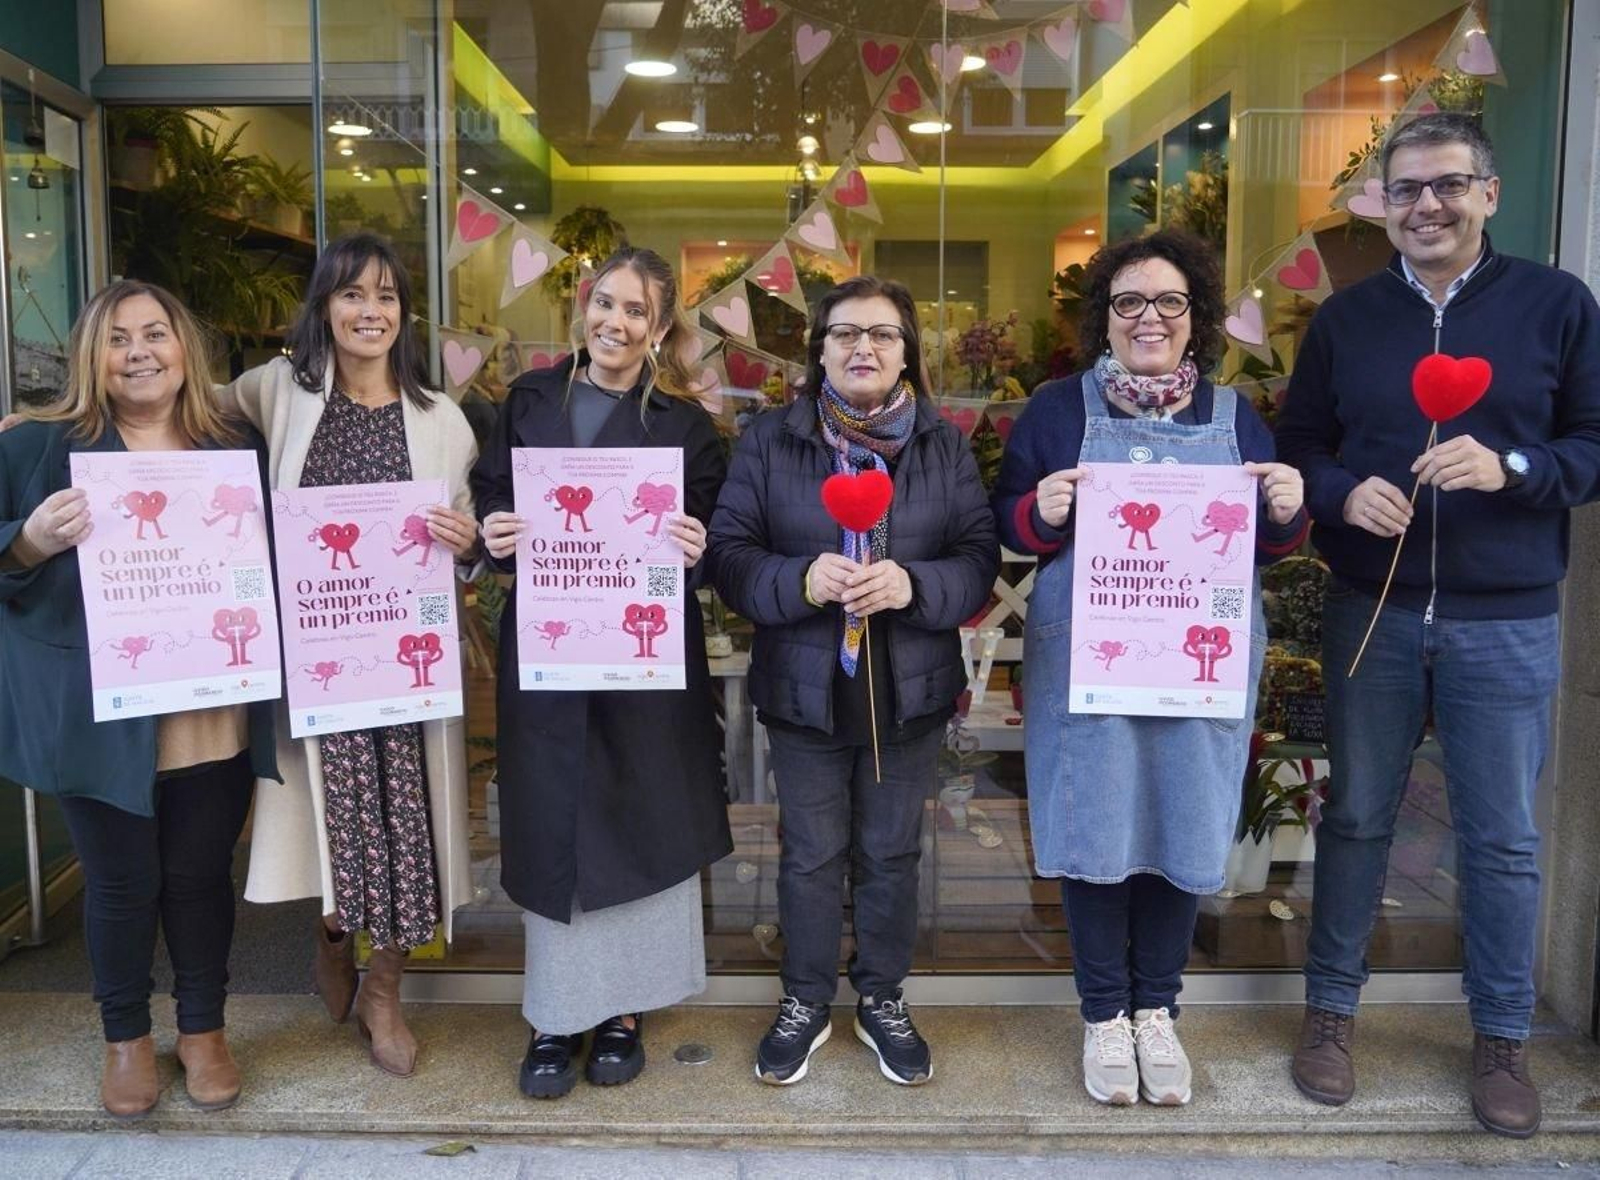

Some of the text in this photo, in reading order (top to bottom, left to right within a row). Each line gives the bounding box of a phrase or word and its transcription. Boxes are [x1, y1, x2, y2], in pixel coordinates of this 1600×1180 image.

[532, 538, 606, 554] O amor
[98, 547, 185, 566] O amor
[532, 553, 629, 573] sempre é
[1091, 555, 1171, 573] O amor
[100, 558, 212, 584] sempre é
[103, 578, 222, 602] un premio
[296, 576, 375, 595] O amor
[532, 572, 636, 590] un premio
[1090, 572, 1192, 593] sempre é
[298, 592, 381, 612] sempre
[385, 586, 399, 604] é
[1089, 592, 1200, 610] un premio
[299, 605, 408, 630] un premio
